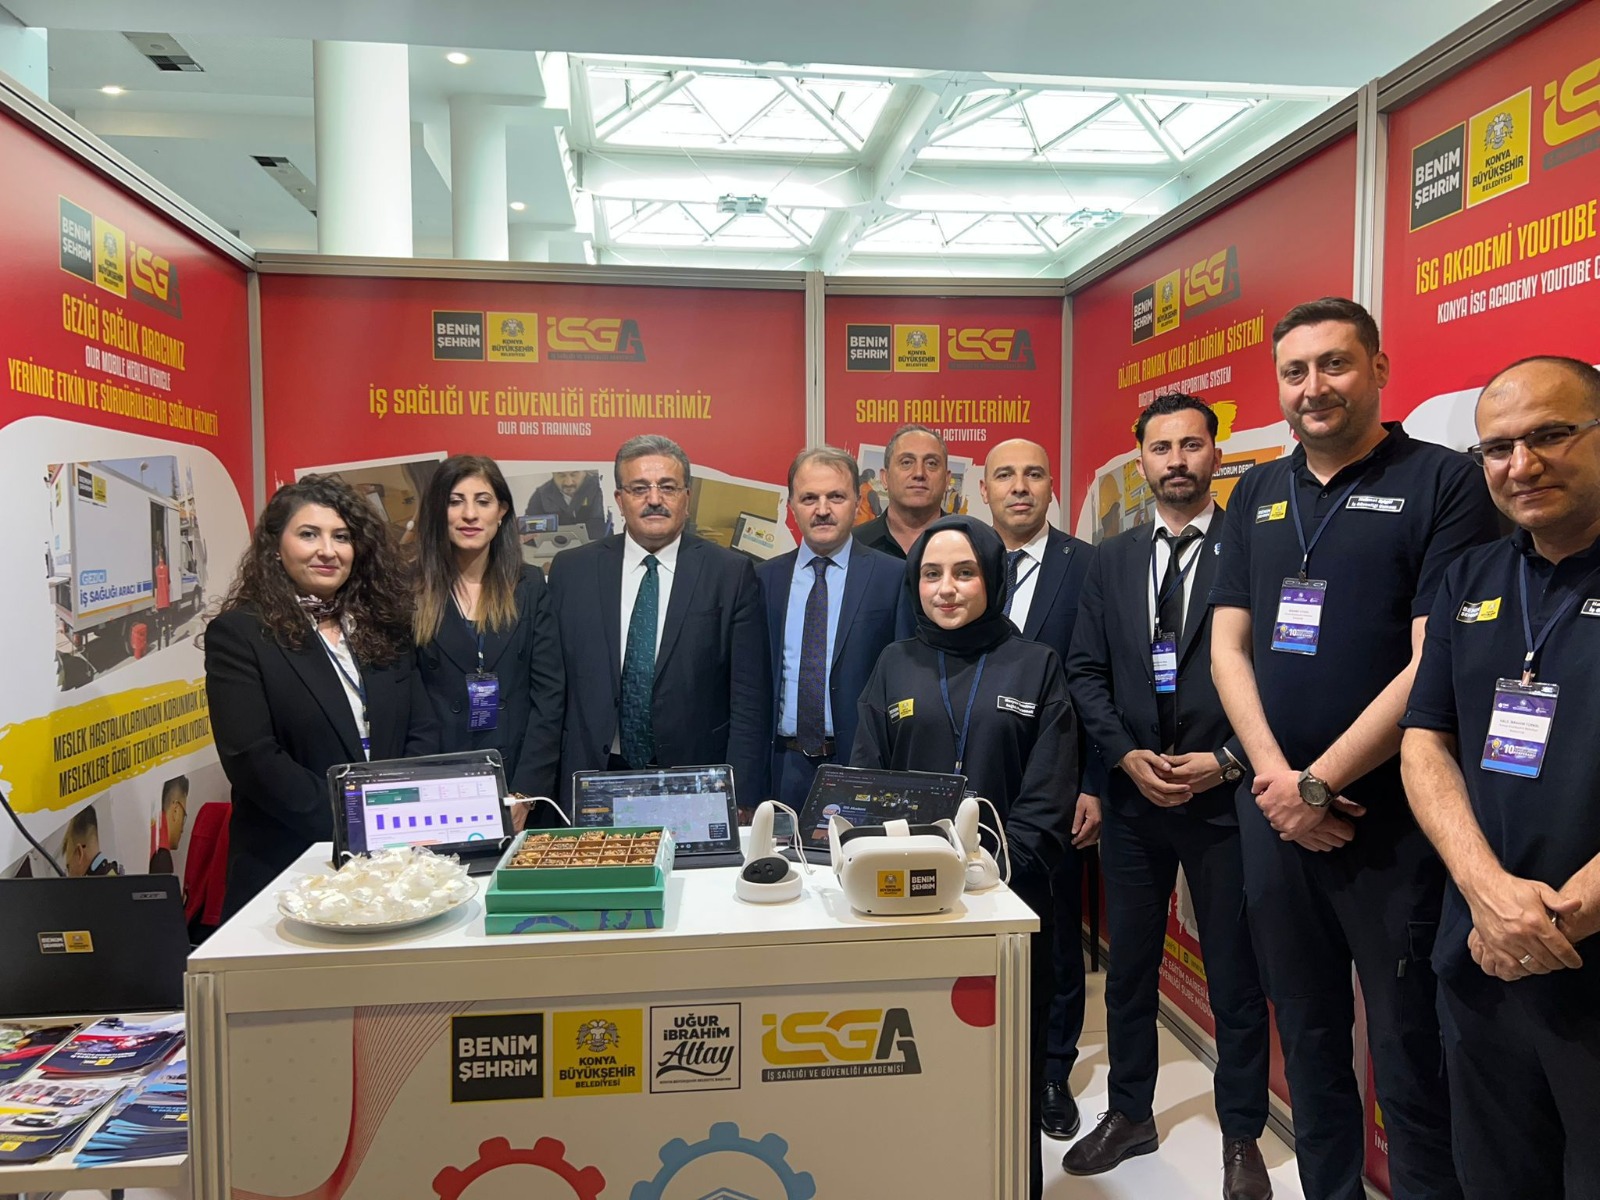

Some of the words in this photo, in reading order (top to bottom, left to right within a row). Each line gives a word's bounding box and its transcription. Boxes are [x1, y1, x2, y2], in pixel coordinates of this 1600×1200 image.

[1472, 154, 1524, 188] BÜYÜKŞEHİR
[1485, 148, 1511, 168] KONYA
[1415, 256, 1440, 295] İSG
[1442, 222, 1512, 286] AKADEMİ
[1517, 199, 1597, 261] YOUTUBE
[1437, 295, 1468, 325] KONYA
[1469, 288, 1487, 316] İSG
[1489, 274, 1539, 309] ACADEMY
[1541, 258, 1592, 294] YOUTUBE
[63, 293, 100, 341] GEZİCİ
[102, 306, 140, 355] SAĞLIK
[141, 325, 186, 371] ARACIMIZ
[1142, 351, 1167, 381] RAMAK
[1167, 344, 1187, 373] KALA
[1188, 327, 1225, 367] BİLDİRİM
[1227, 308, 1264, 354] SİSTEMİ
[85, 345, 101, 370] OUR
[101, 350, 126, 378] MOBILE
[1209, 366, 1232, 388] SYSTEM
[8, 356, 55, 400] YERİNDE
[57, 369, 86, 406] ETKİN
[86, 379, 99, 409] VE
[168, 399, 194, 431] SAĞLIK
[369, 383, 388, 419] İŞ
[393, 384, 464, 416] SAĞLIĞI
[469, 390, 490, 417] VE
[495, 386, 585, 418] GÜVENLİĞİ
[590, 387, 712, 420] EĞİTİMLERİMİZ
[855, 399, 899, 424] SAHA
[904, 394, 1031, 424] FAALİYETLERİMİZ
[497, 421, 518, 436] OUR
[519, 422, 540, 436] OHS
[541, 422, 592, 436] TRAININGS
[943, 428, 987, 442] ACTIVITIES
[80, 589, 88, 608] İŞ
[89, 585, 118, 603] SAĞLIĞI
[53, 726, 88, 763] MESLEK
[89, 702, 162, 750] HASTALIKLARINDAN
[163, 690, 199, 722] KORUNMAK
[59, 754, 110, 798] MESLEKLERE
[111, 741, 132, 775] ÖZGÜ
[133, 726, 169, 766] TETKİKLERİ
[171, 715, 209, 750] PLANLIYORUZ
[1504, 743, 1515, 755] 10
[674, 1012, 719, 1028] UĞUR
[559, 1065, 636, 1081] BÜYÜKŞEHİR
[579, 1055, 617, 1067] KONYA
[656, 1040, 735, 1078] Altay
[767, 1070, 776, 1081] İŞ
[776, 1069, 807, 1080] SAĞLIĞI
[808, 1068, 819, 1079] VE
[820, 1067, 861, 1078] GÜVENLİĞİ
[863, 1064, 905, 1076] AKADEMİSİ
[575, 1078, 621, 1089] BELEDİYESİ
